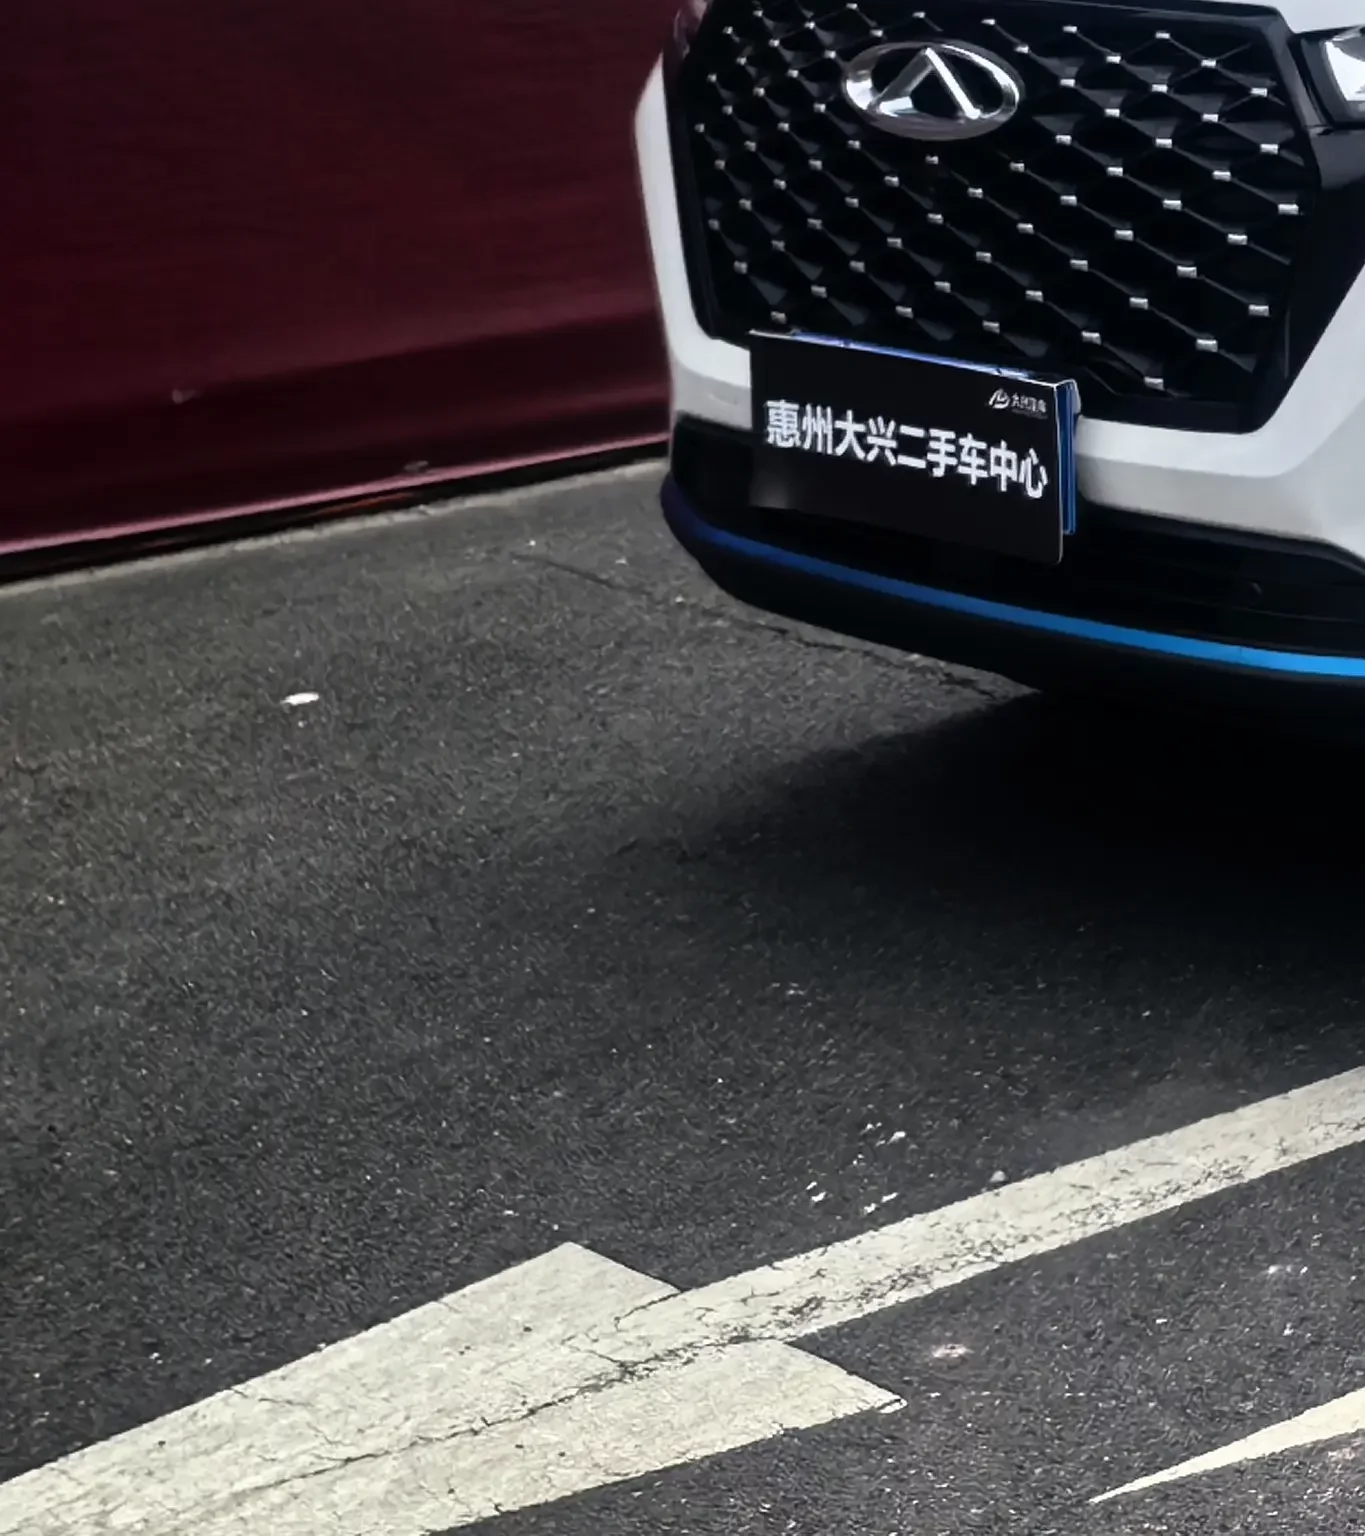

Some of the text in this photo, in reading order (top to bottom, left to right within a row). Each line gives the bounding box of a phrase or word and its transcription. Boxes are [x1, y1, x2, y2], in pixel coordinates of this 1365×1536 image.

[764, 398, 1049, 499] 惠州大兴二手车中心
